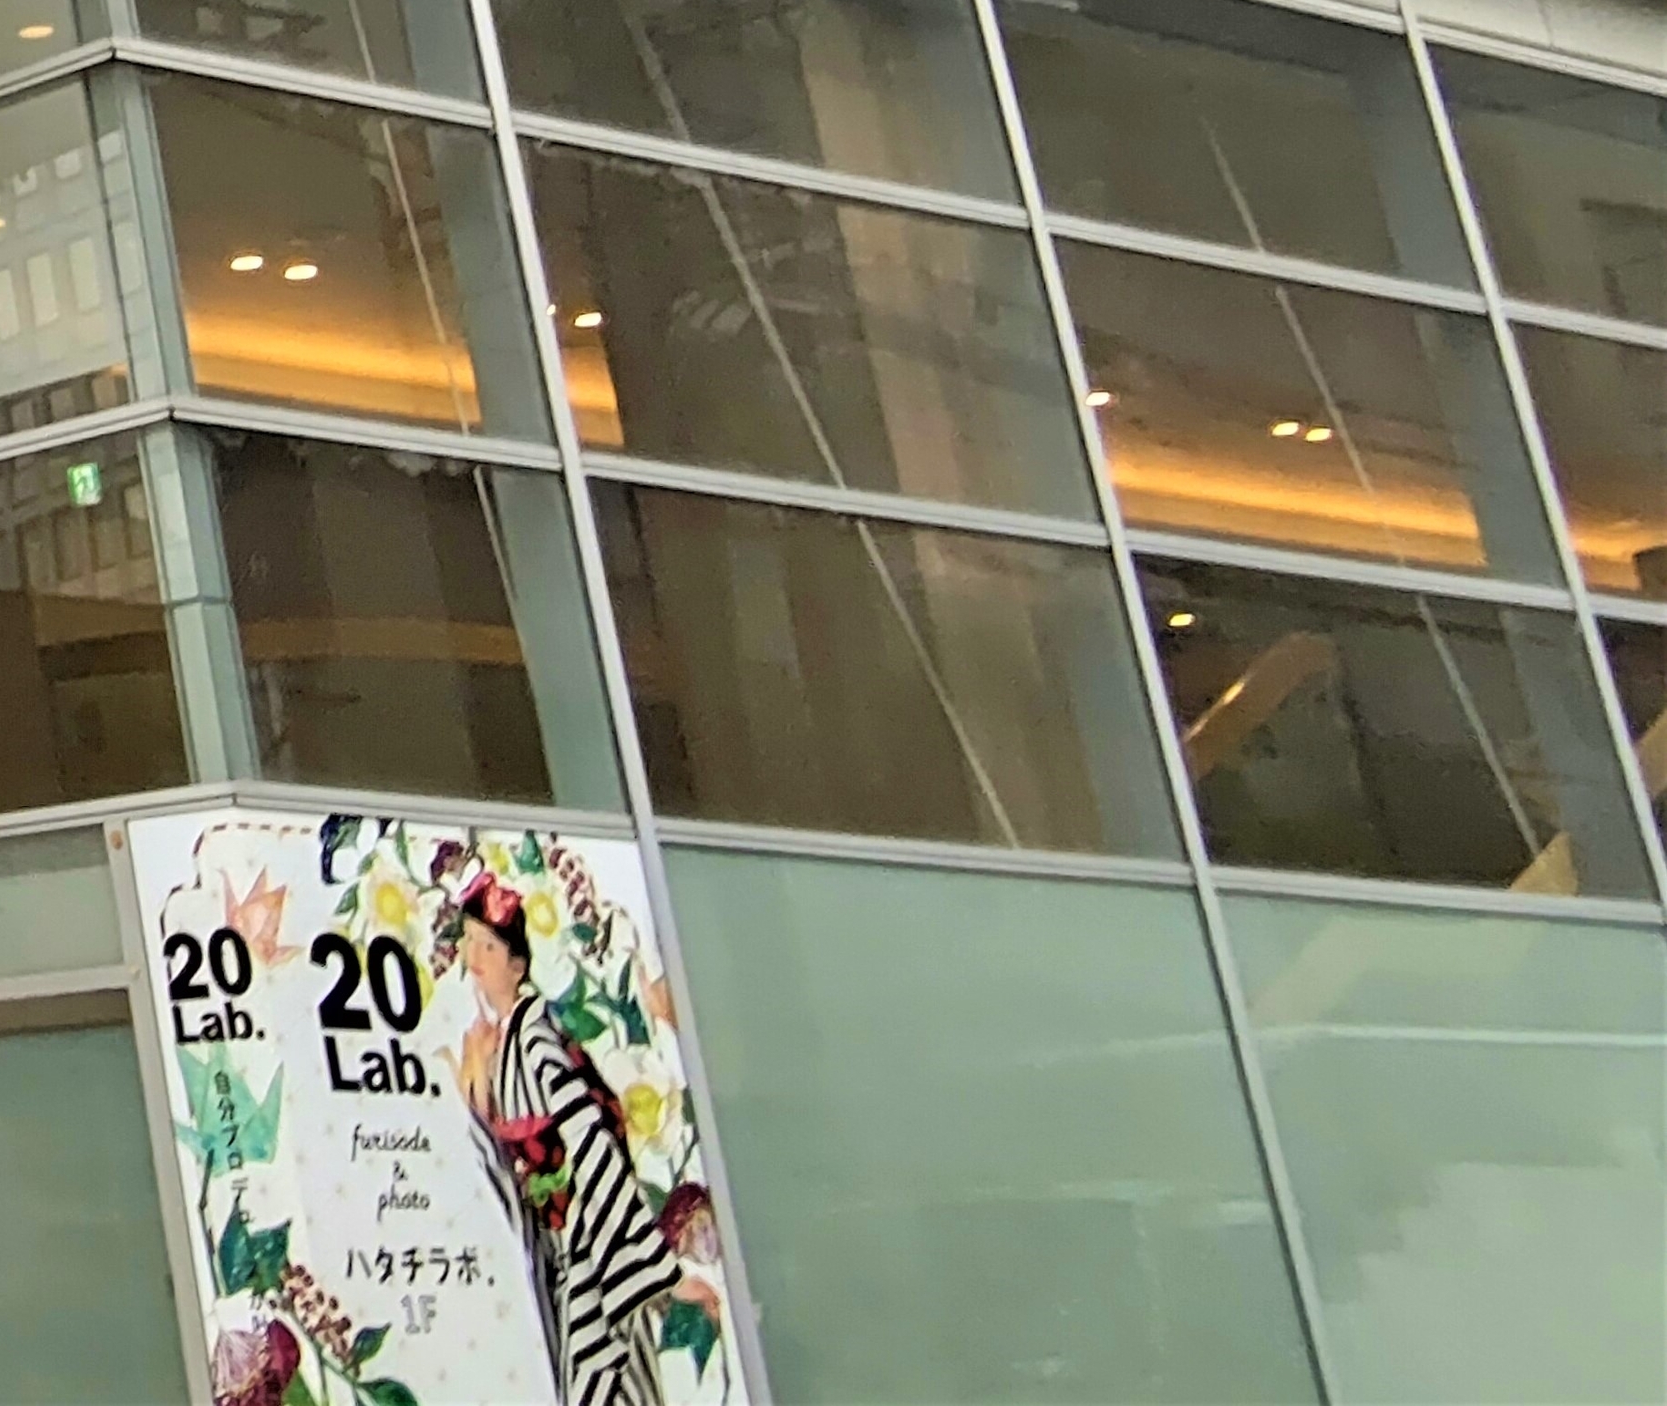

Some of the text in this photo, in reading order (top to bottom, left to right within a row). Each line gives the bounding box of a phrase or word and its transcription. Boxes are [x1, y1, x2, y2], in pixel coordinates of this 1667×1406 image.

[164, 928, 252, 1001] 20
[310, 932, 423, 1034] 20
[173, 1002, 265, 1044] Lab.
[324, 1036, 441, 1097] Lab.
[351, 1124, 432, 1161] furisode
[376, 1183, 430, 1222] photo
[401, 1294, 436, 1334] 1F
